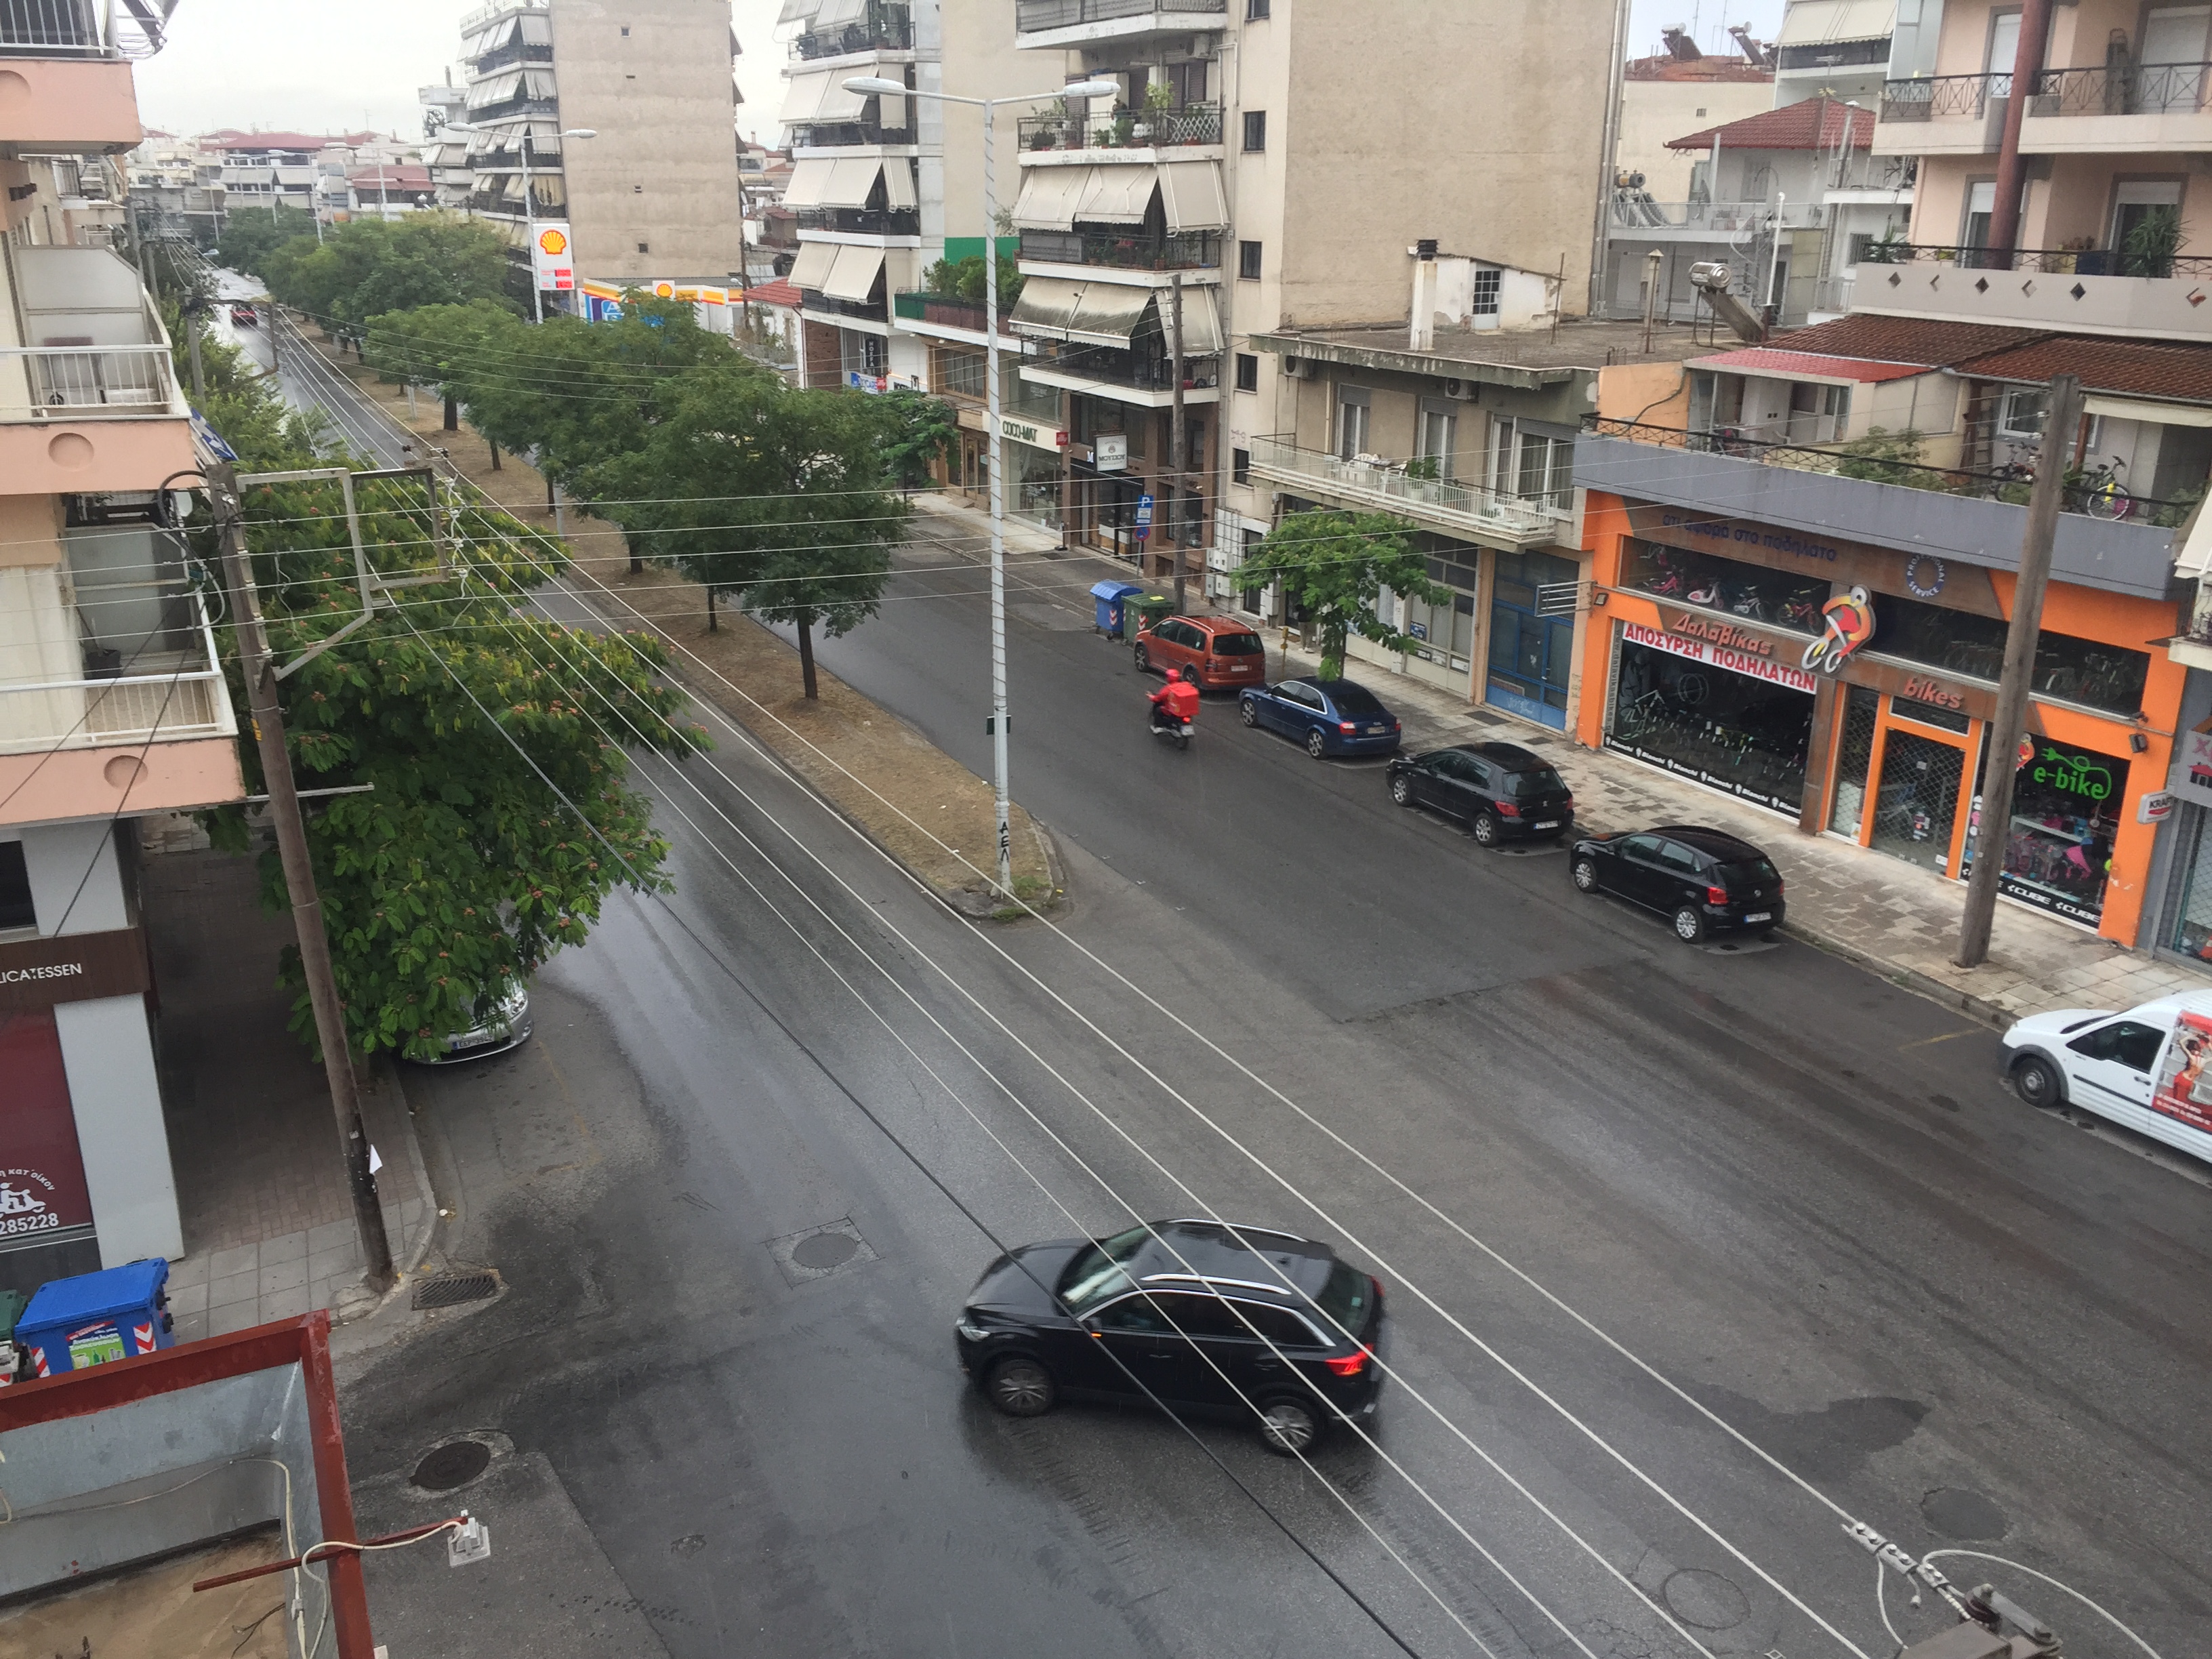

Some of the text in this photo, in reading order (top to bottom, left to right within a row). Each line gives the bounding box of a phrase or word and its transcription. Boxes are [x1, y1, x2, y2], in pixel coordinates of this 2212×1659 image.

[1002, 420, 1038, 443] COCO-MAT
[1624, 623, 1816, 692] ΑΠΟΣΥΡΣΗ ΠΟΔΗΛΑΤΩΝ
[1904, 678, 1962, 709] bikes
[2034, 766, 2105, 800] e-bike
